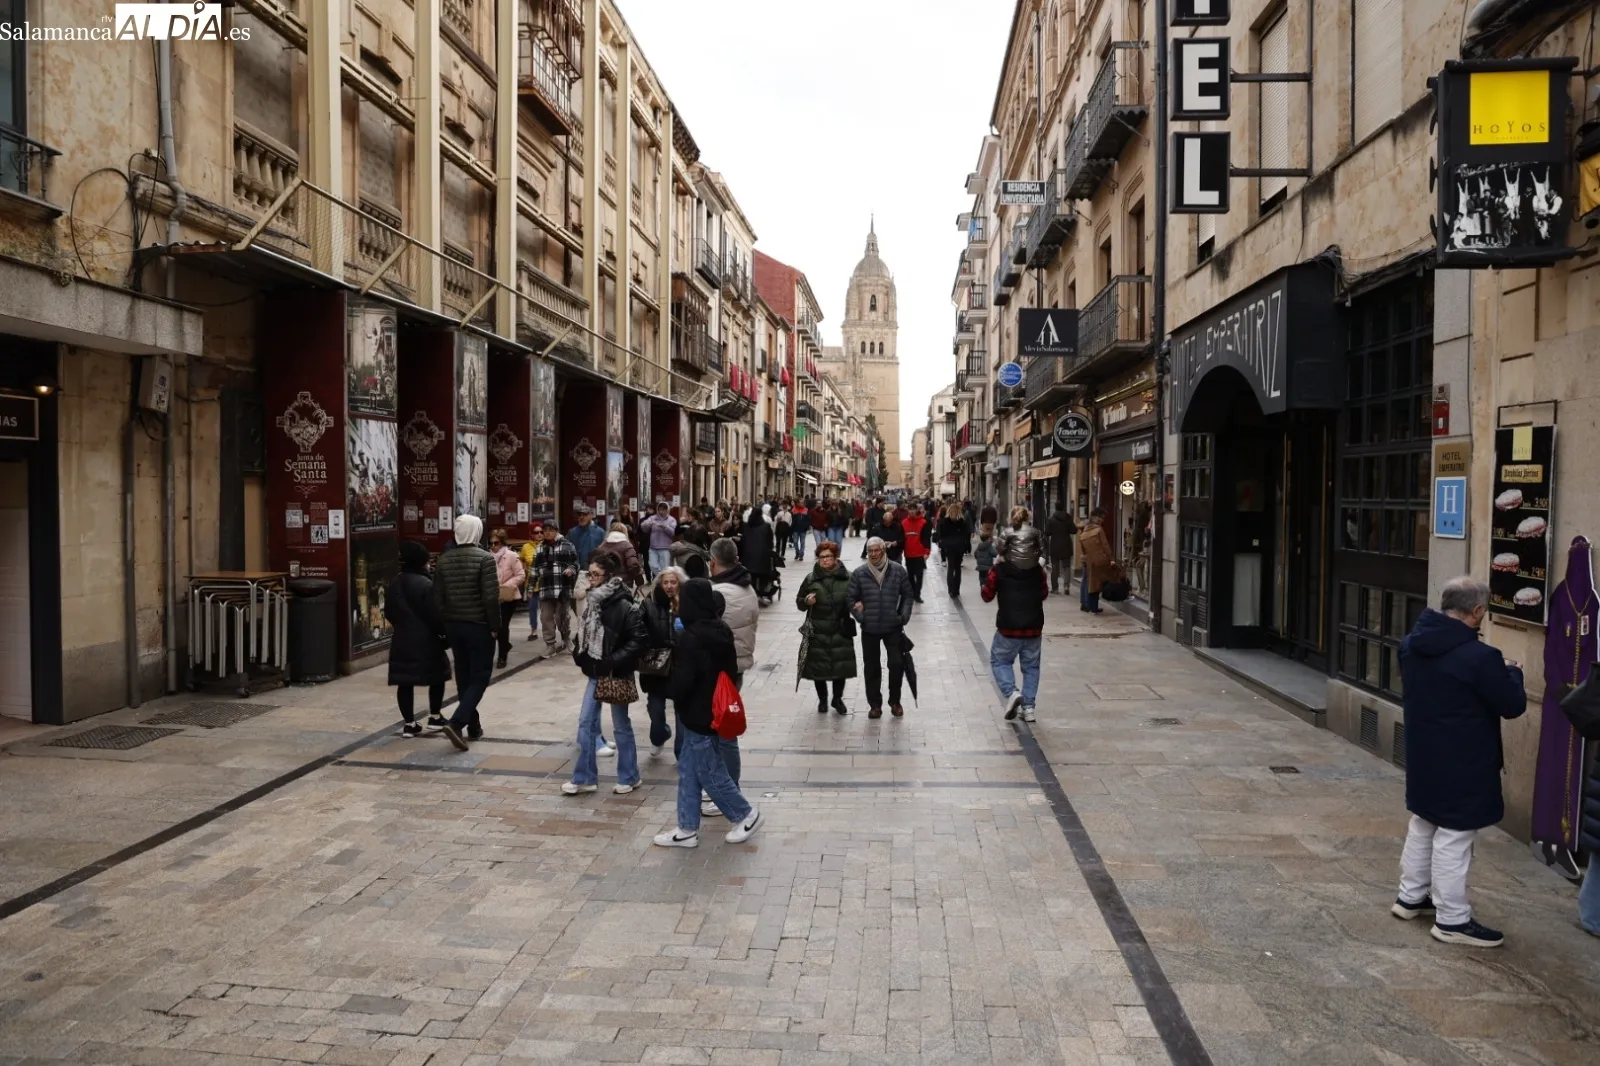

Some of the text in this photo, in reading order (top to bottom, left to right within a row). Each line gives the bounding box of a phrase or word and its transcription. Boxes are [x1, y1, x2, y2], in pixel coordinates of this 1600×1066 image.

[1473, 121, 1546, 134] HOYOS
[1007, 183, 1041, 192] RESIDENCIA
[1003, 193, 1045, 203] UNIVERSITARIA
[1206, 290, 1282, 398] EMPERATRIZ
[315, 453, 324, 461] de
[1442, 452, 1461, 461] HOTEL
[284, 459, 327, 472] Semana
[403, 464, 438, 476] Semana
[1438, 463, 1465, 472] EMPERATRIZ
[293, 470, 327, 483] Santa
[488, 468, 517, 478] Semana
[410, 473, 438, 484] Santa
[494, 475, 517, 485] Santa
[1441, 485, 1459, 514] H
